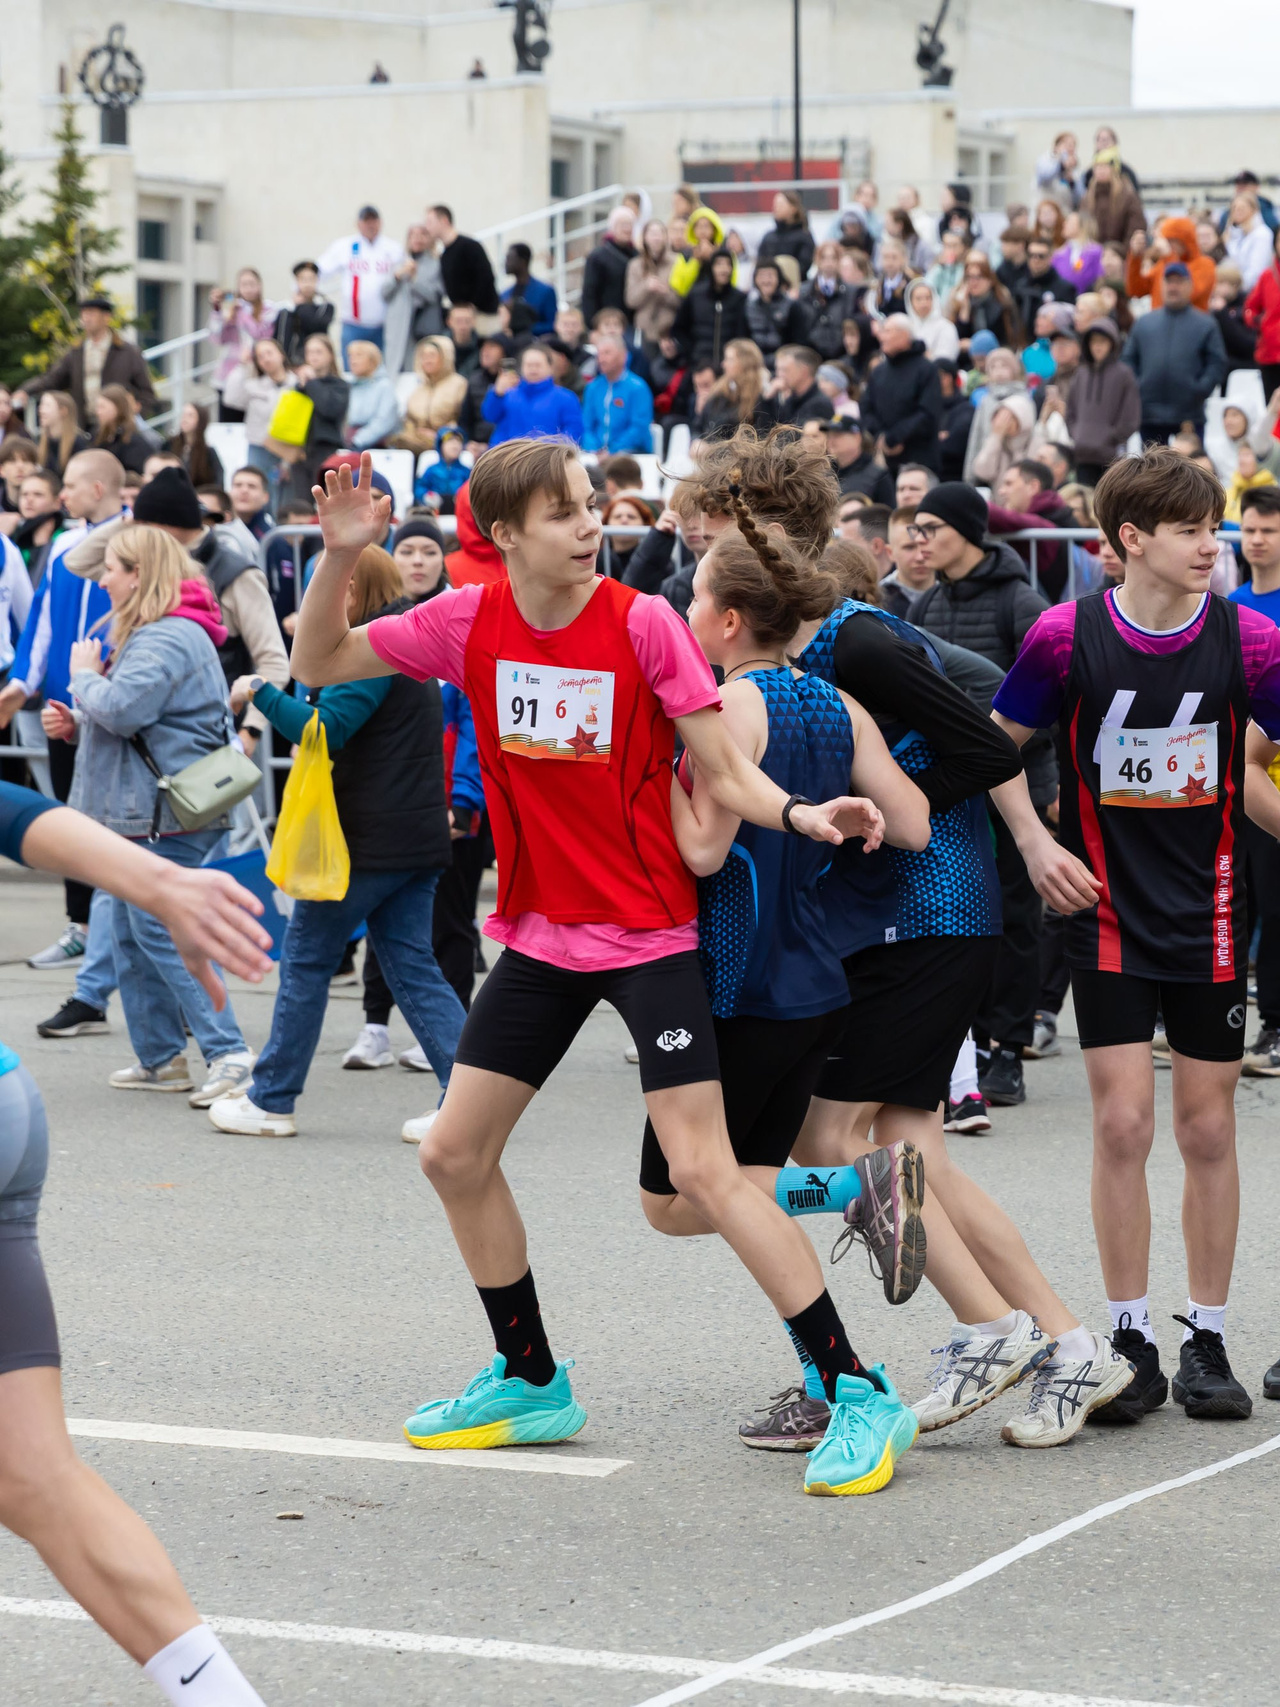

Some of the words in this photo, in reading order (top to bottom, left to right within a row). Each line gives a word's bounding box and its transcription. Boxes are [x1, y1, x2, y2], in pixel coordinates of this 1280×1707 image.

[557, 674, 603, 695] Эстафета
[511, 696, 538, 728] 91
[556, 699, 567, 719] 6
[1166, 727, 1207, 748] Эстафета
[1118, 757, 1152, 784] 46
[1167, 754, 1178, 772] 6
[1219, 855, 1230, 870] РАЗ
[1218, 888, 1230, 912] НАЧАЛ
[1217, 920, 1231, 967] ПОБЕЖДАЙ
[787, 1189, 825, 1209] PUMA
